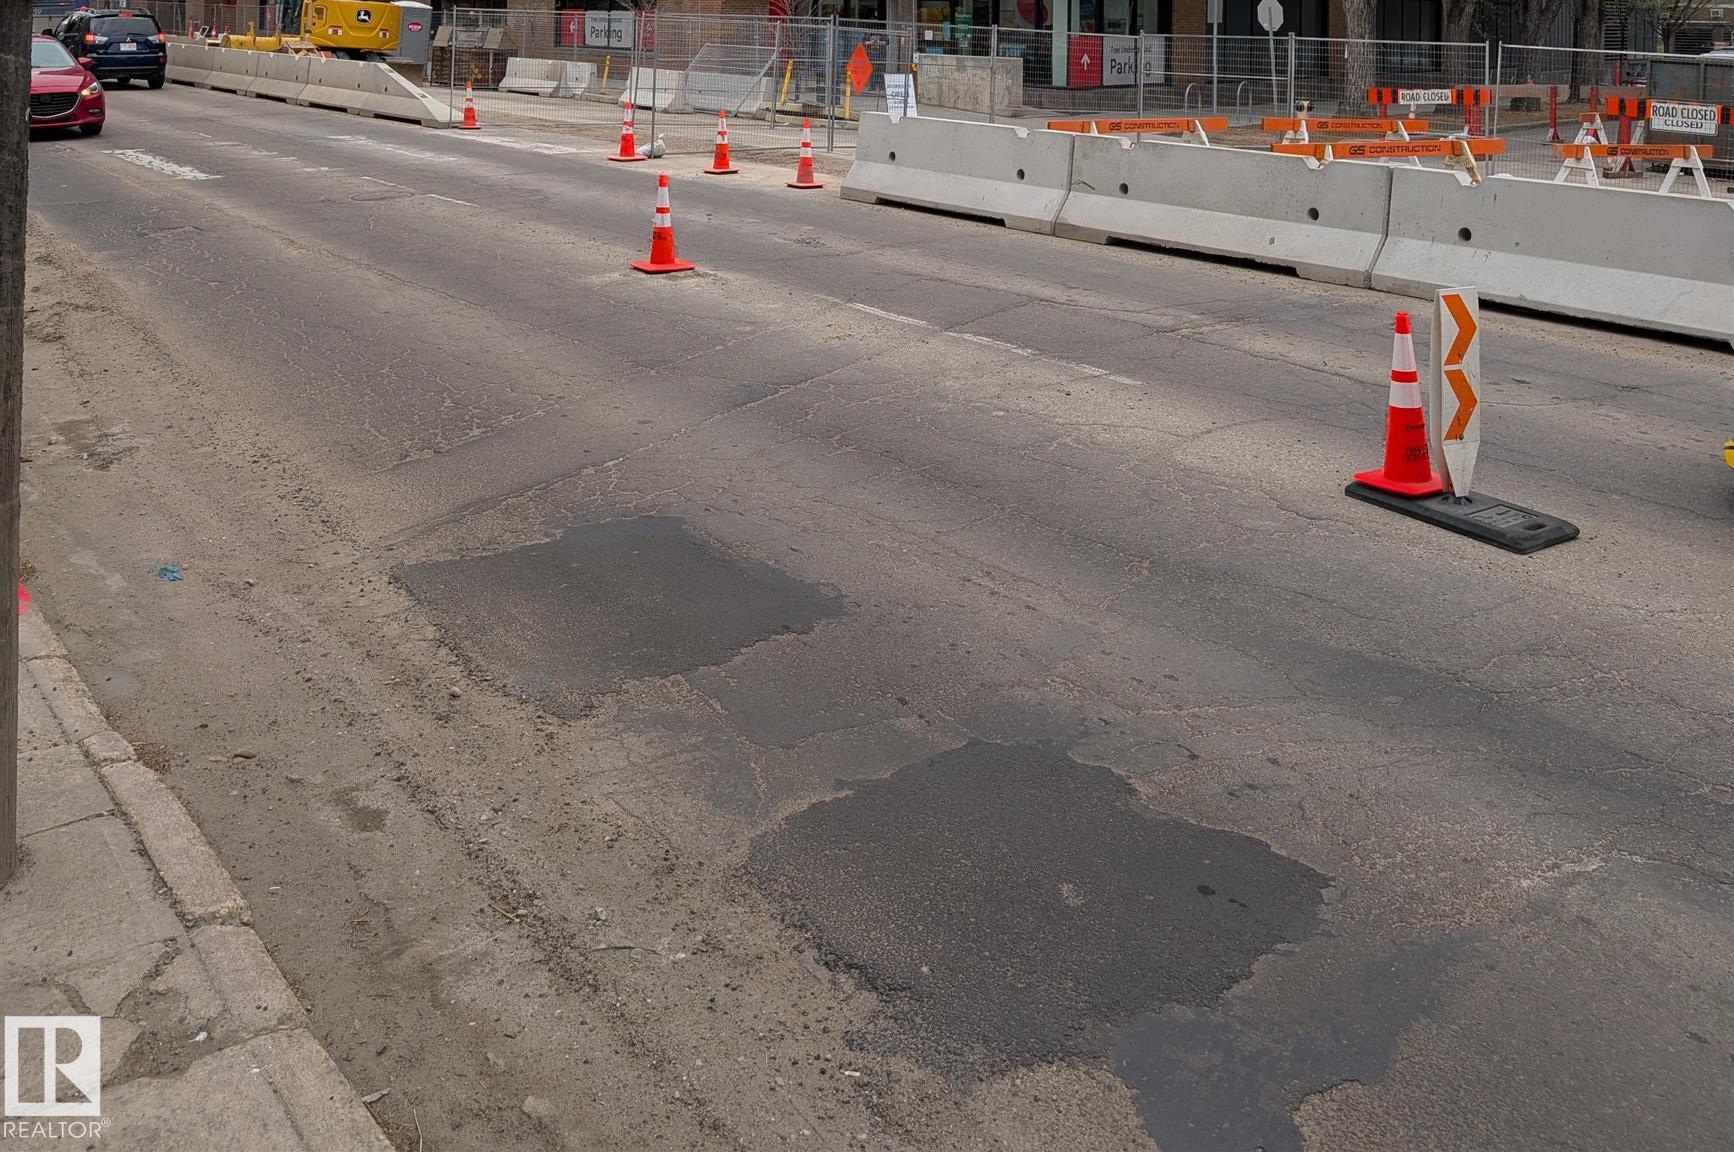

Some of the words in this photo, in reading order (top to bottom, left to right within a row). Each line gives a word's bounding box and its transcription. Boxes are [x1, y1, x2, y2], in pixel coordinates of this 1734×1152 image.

[1110, 55, 1152, 78] Parkg
[1401, 92, 1421, 102] ROAD
[1422, 91, 1449, 102] CLOSED
[1652, 105, 1678, 118] ROAD
[1680, 107, 1716, 122] CLOSED
[1108, 121, 1122, 131] GS
[1124, 121, 1180, 130] CONSTRUCTION
[1316, 121, 1329, 129] GS
[1331, 121, 1383, 129] CONSTRUCTION
[1348, 145, 1365, 155] GS
[1369, 144, 1442, 154] CONSTRUCTION
[1606, 146, 1618, 156] GS
[1620, 147, 1670, 156] CONSTRUCTION
